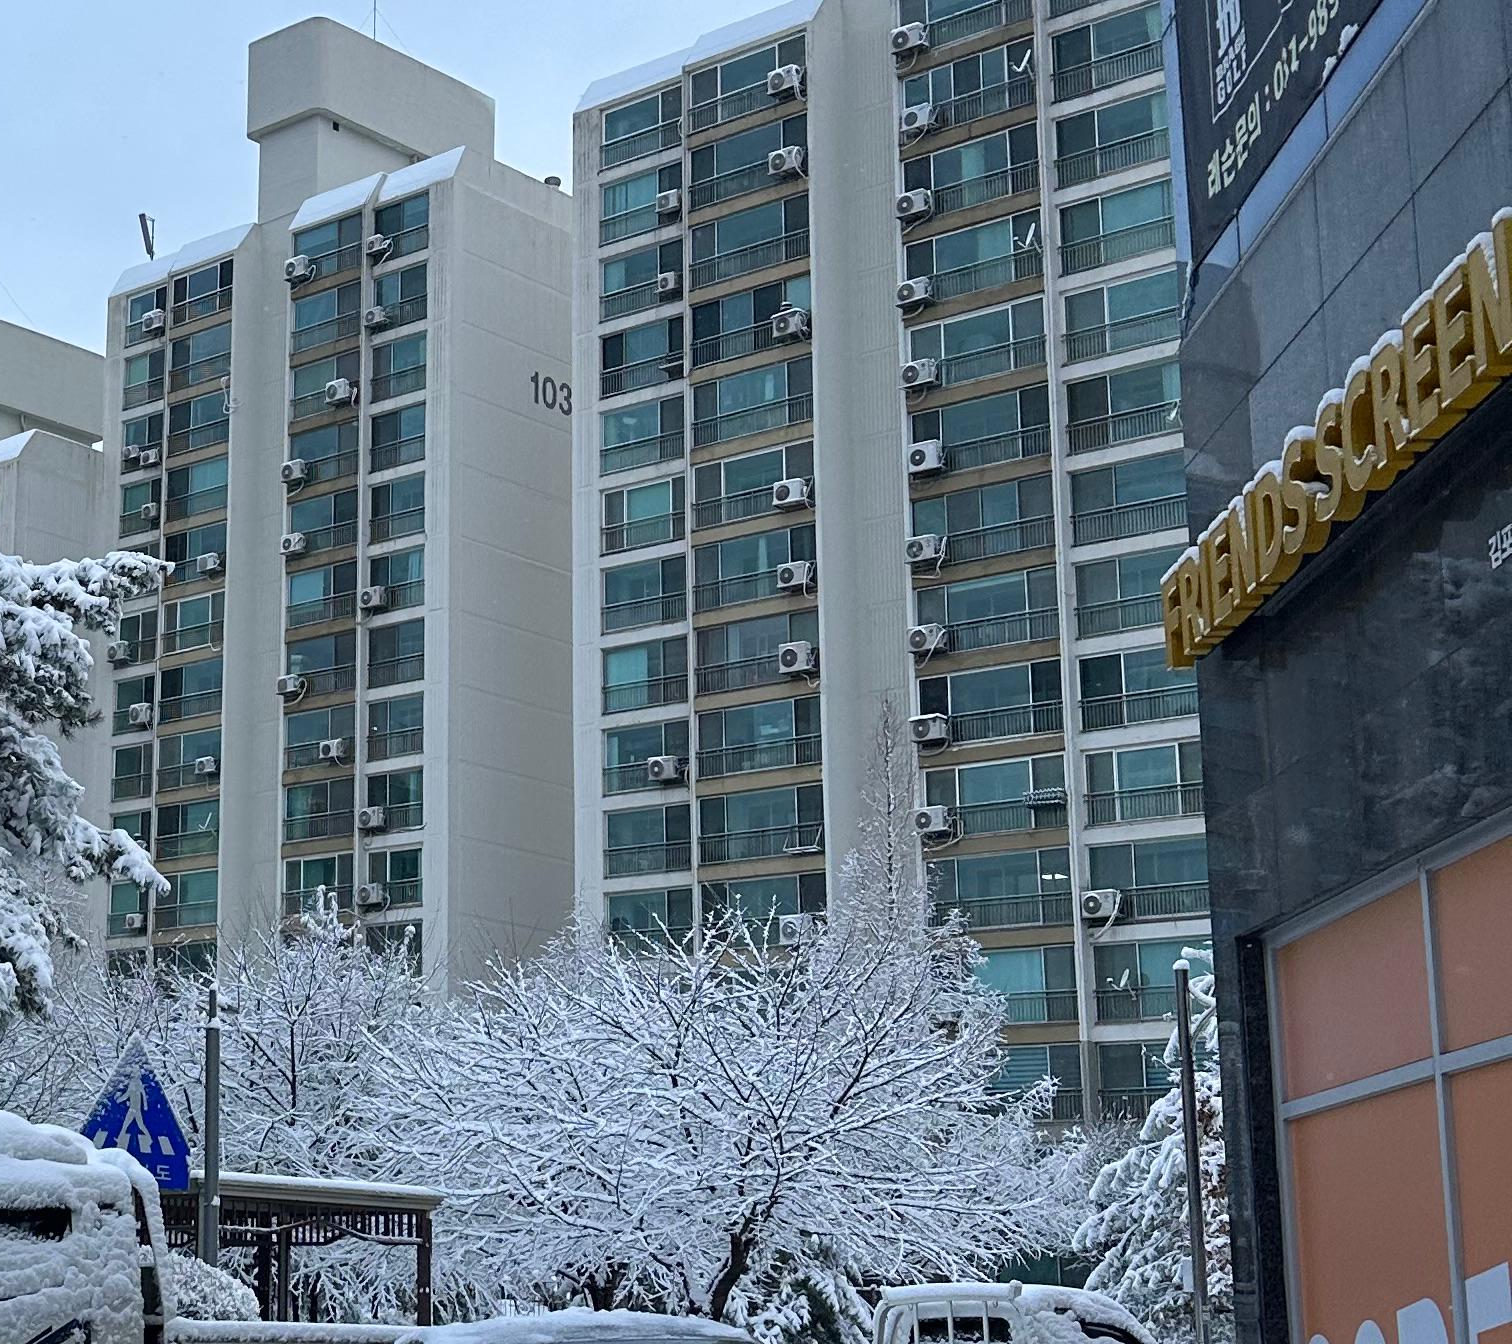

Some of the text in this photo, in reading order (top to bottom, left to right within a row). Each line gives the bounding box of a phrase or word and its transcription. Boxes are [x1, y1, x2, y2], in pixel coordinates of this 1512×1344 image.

[1207, 91, 1261, 198] 레슨문의
[530, 370, 573, 416] 103
[1161, 216, 1512, 670] FRIENDS SCREEN
